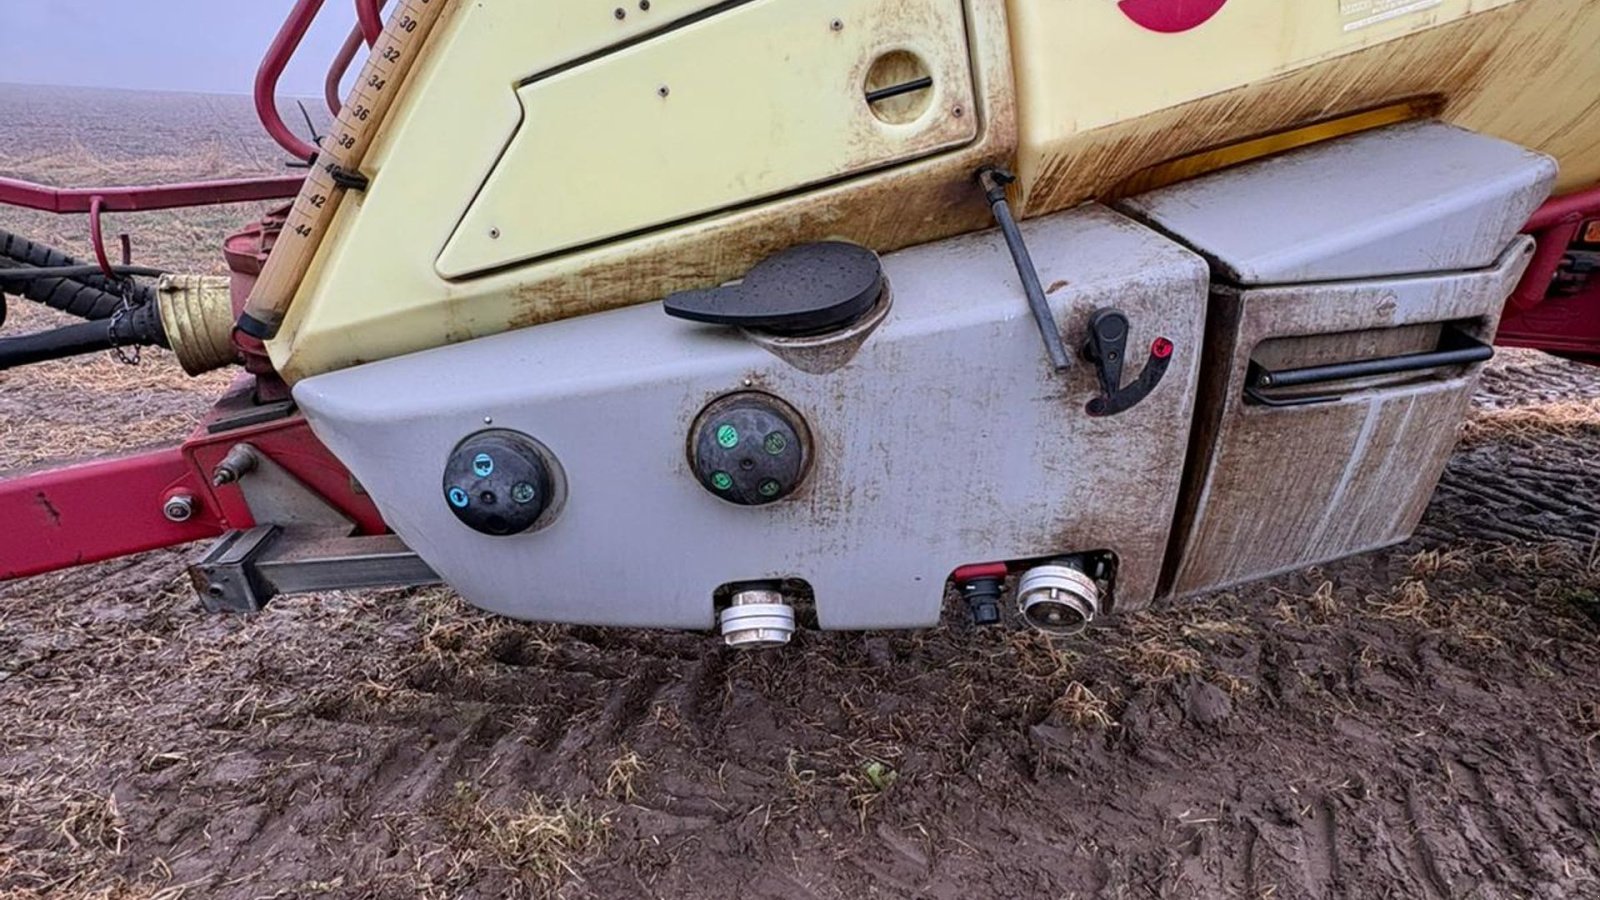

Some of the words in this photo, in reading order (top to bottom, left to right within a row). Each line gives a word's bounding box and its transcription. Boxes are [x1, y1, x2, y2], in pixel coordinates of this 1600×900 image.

[400, 16, 417, 33] 30
[383, 46, 400, 63] 32
[368, 75, 386, 91] 34
[353, 105, 370, 121] 36
[338, 133, 355, 150] 38
[310, 194, 326, 209] 42
[295, 224, 312, 238] 44
